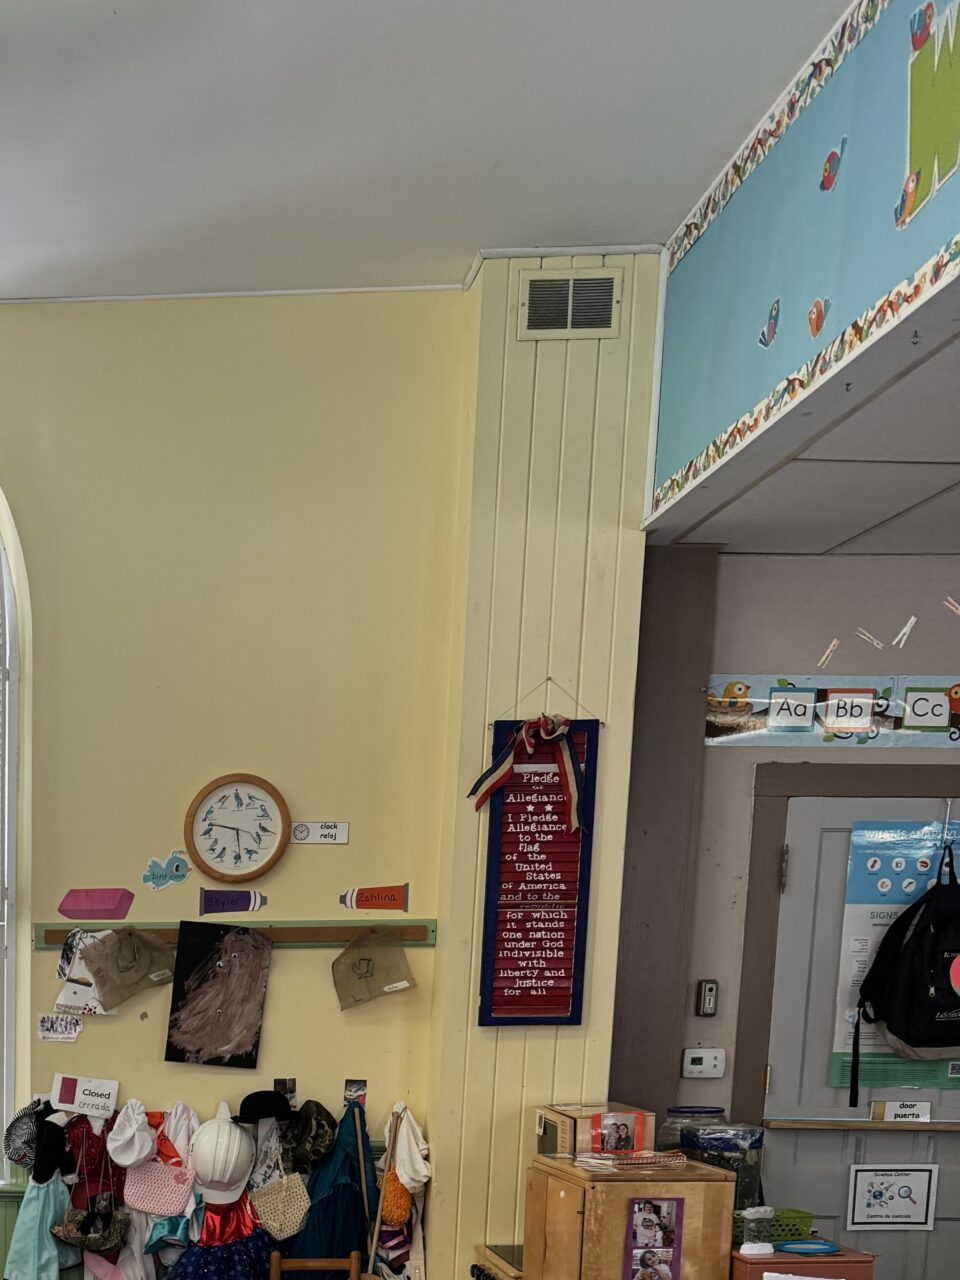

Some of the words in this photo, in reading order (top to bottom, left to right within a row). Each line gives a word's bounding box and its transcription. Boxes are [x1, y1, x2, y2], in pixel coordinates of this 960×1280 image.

[776, 698, 808, 718] Aa
[836, 699, 864, 719] Bb
[911, 697, 944, 718] Cc
[521, 771, 560, 783] Pledge
[520, 813, 559, 822] Pledge
[320, 822, 339, 830] clock
[507, 823, 567, 832] Allegiance
[320, 832, 337, 841] reloj
[518, 833, 531, 842] to
[534, 832, 553, 841] the
[518, 843, 540, 852] flag
[505, 853, 518, 861] of
[527, 853, 547, 861] the
[515, 862, 553, 871] United
[151, 872, 167, 880] bird
[169, 872, 187, 880] clock
[525, 872, 562, 881] States
[518, 882, 567, 890] America
[500, 892, 522, 901] and
[542, 892, 561, 900] the
[506, 911, 524, 919] for
[531, 910, 568, 919] which
[506, 921, 517, 929] it
[526, 920, 565, 928] stands
[529, 931, 565, 939] nation
[504, 940, 537, 949] under
[542, 940, 564, 948] God
[498, 949, 565, 958] indivisible
[517, 959, 547, 968] with
[499, 969, 539, 977] liberty
[544, 968, 565, 977] and
[504, 988, 521, 996] for
[82, 1088, 111, 1100] Closed
[79, 1101, 111, 1113] cerrada
[894, 1112, 920, 1120] puerta
